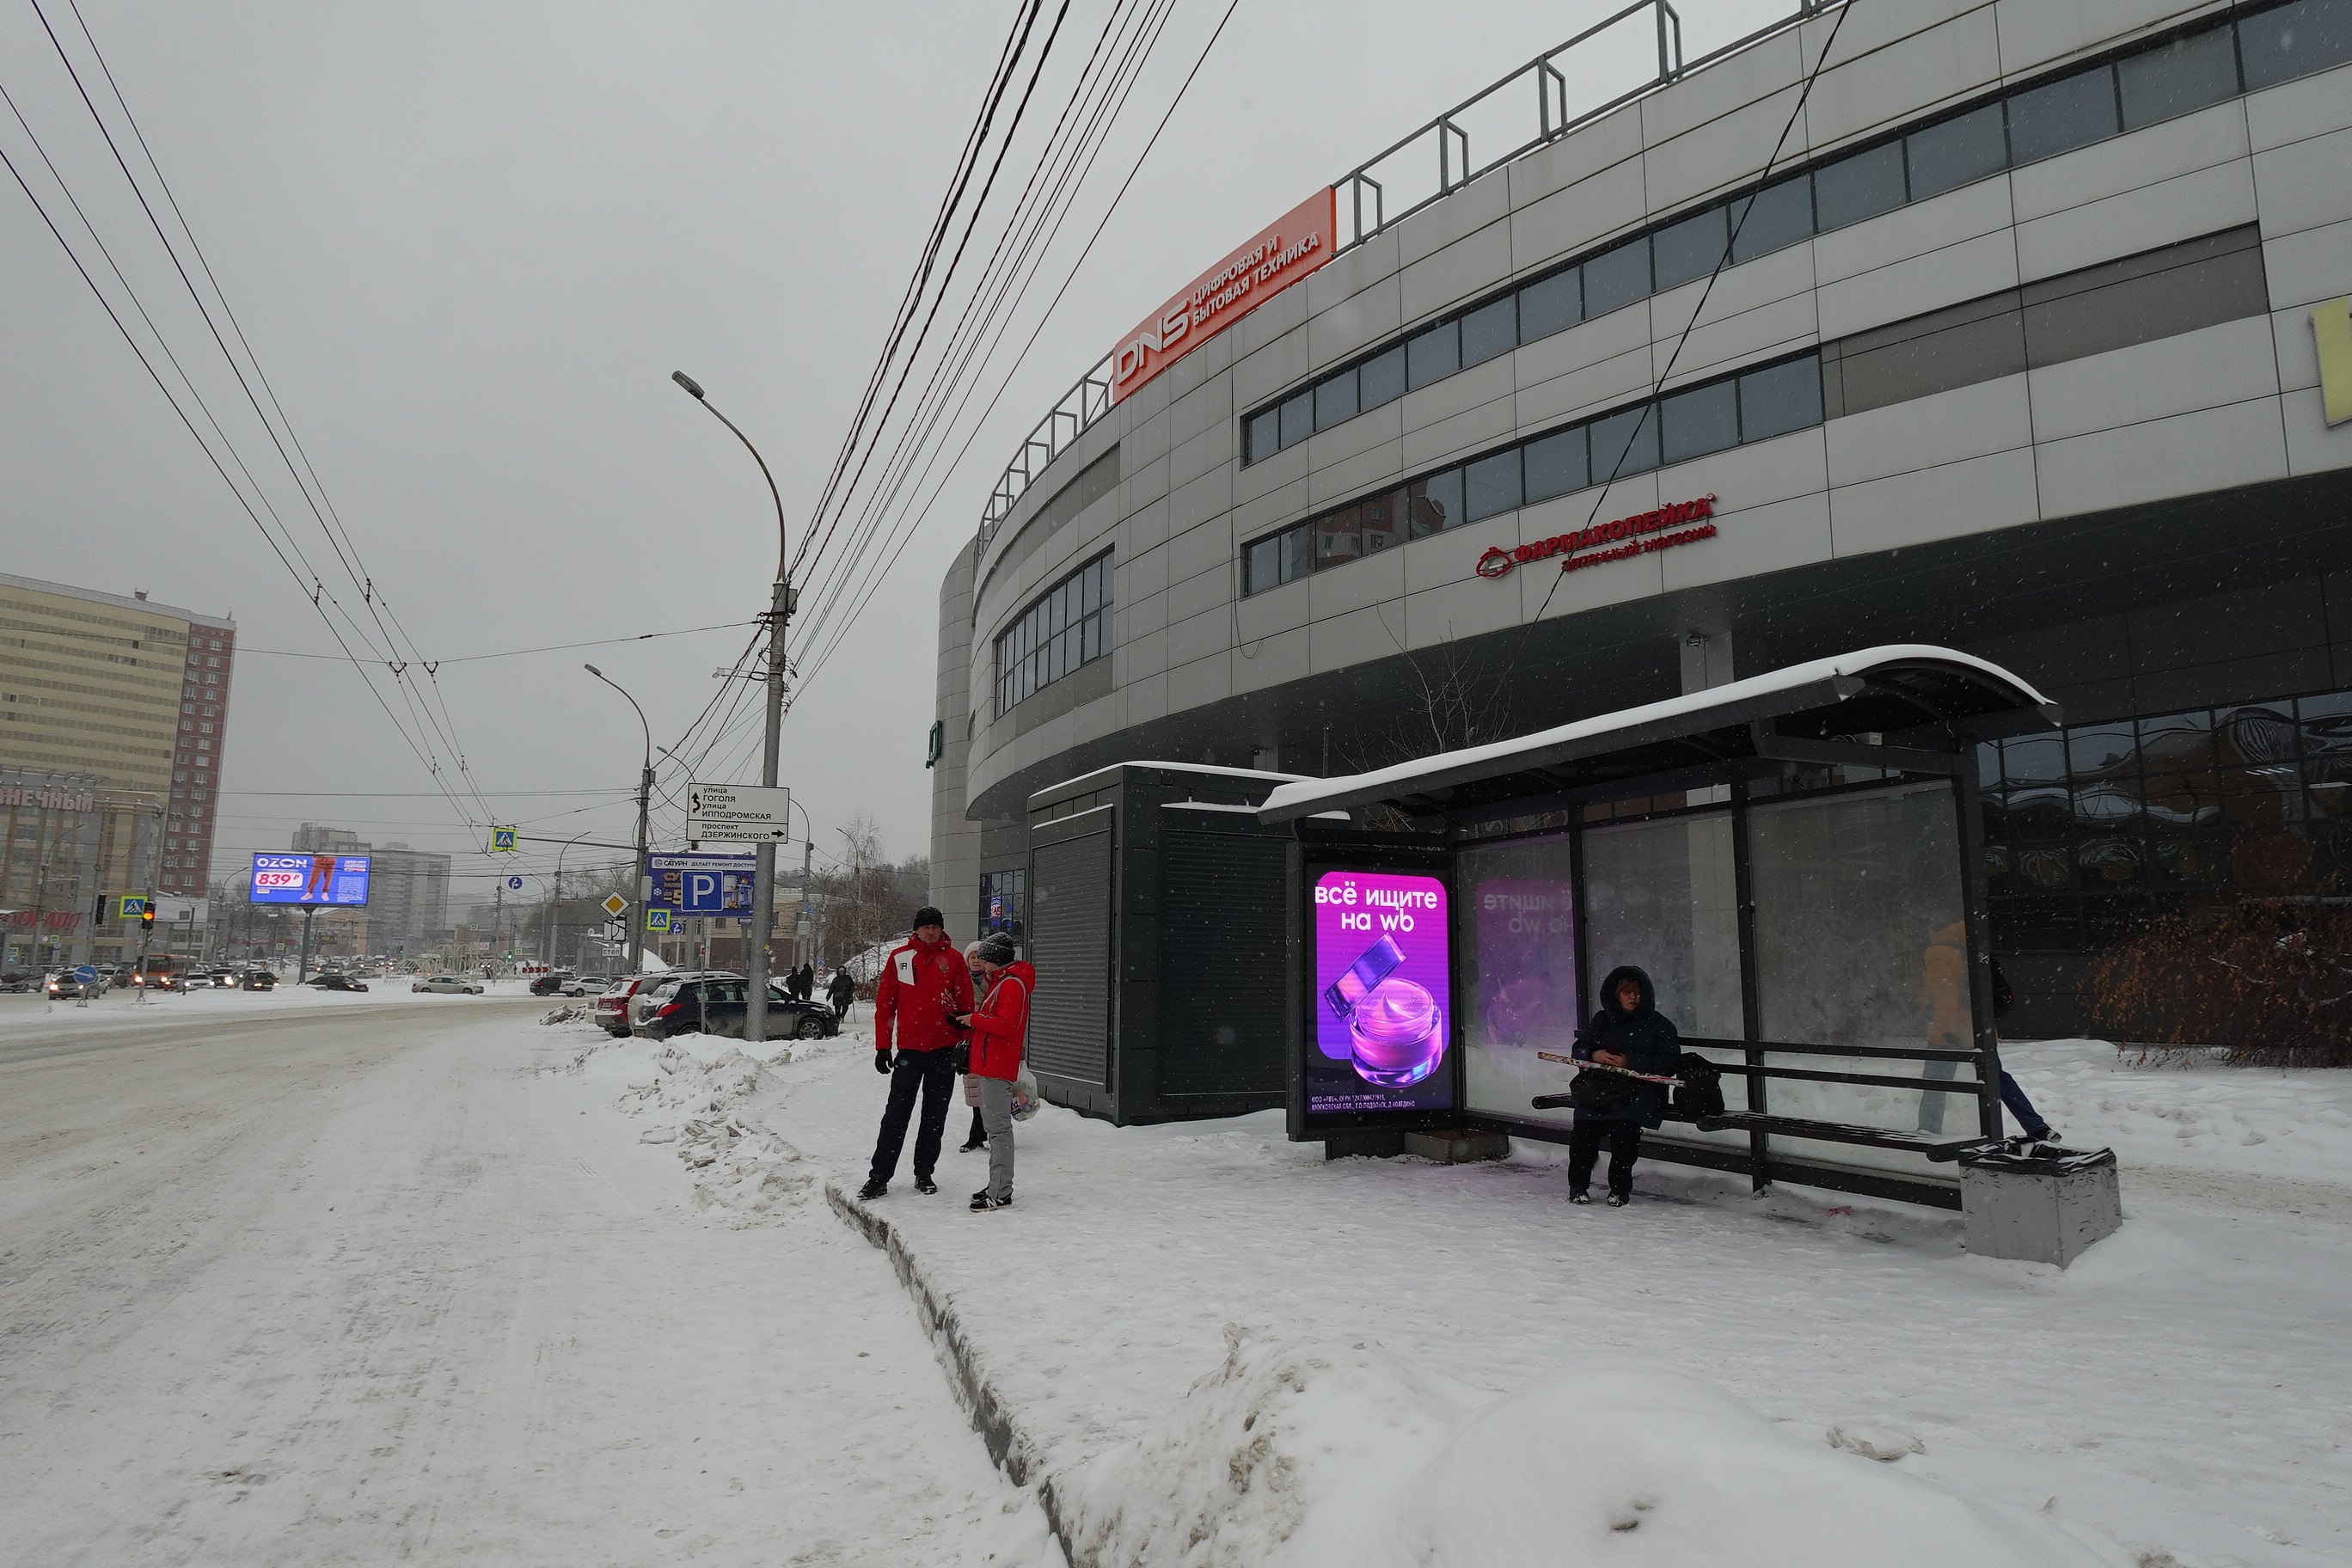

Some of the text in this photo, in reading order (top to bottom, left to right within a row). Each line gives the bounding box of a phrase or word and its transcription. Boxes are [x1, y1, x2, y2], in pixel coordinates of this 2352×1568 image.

[1192, 234, 1279, 306] ЦИФРОВАЯ И
[1193, 231, 1319, 328] БЫТОВАЯ ТЕХНИКА
[1118, 297, 1190, 385] DNS
[1643, 524, 1717, 553] магазин
[703, 794, 736, 803] ГОГОЛЯ
[702, 811, 771, 820] ИППОДРОМСКАЯ
[701, 830, 770, 840] ДЗЕРЖИНСКОГО
[256, 857, 308, 868] OZON
[258, 873, 291, 885] 839
[693, 874, 715, 906] P
[1315, 881, 1438, 911] всё ищите
[1341, 908, 1415, 933] на wb
